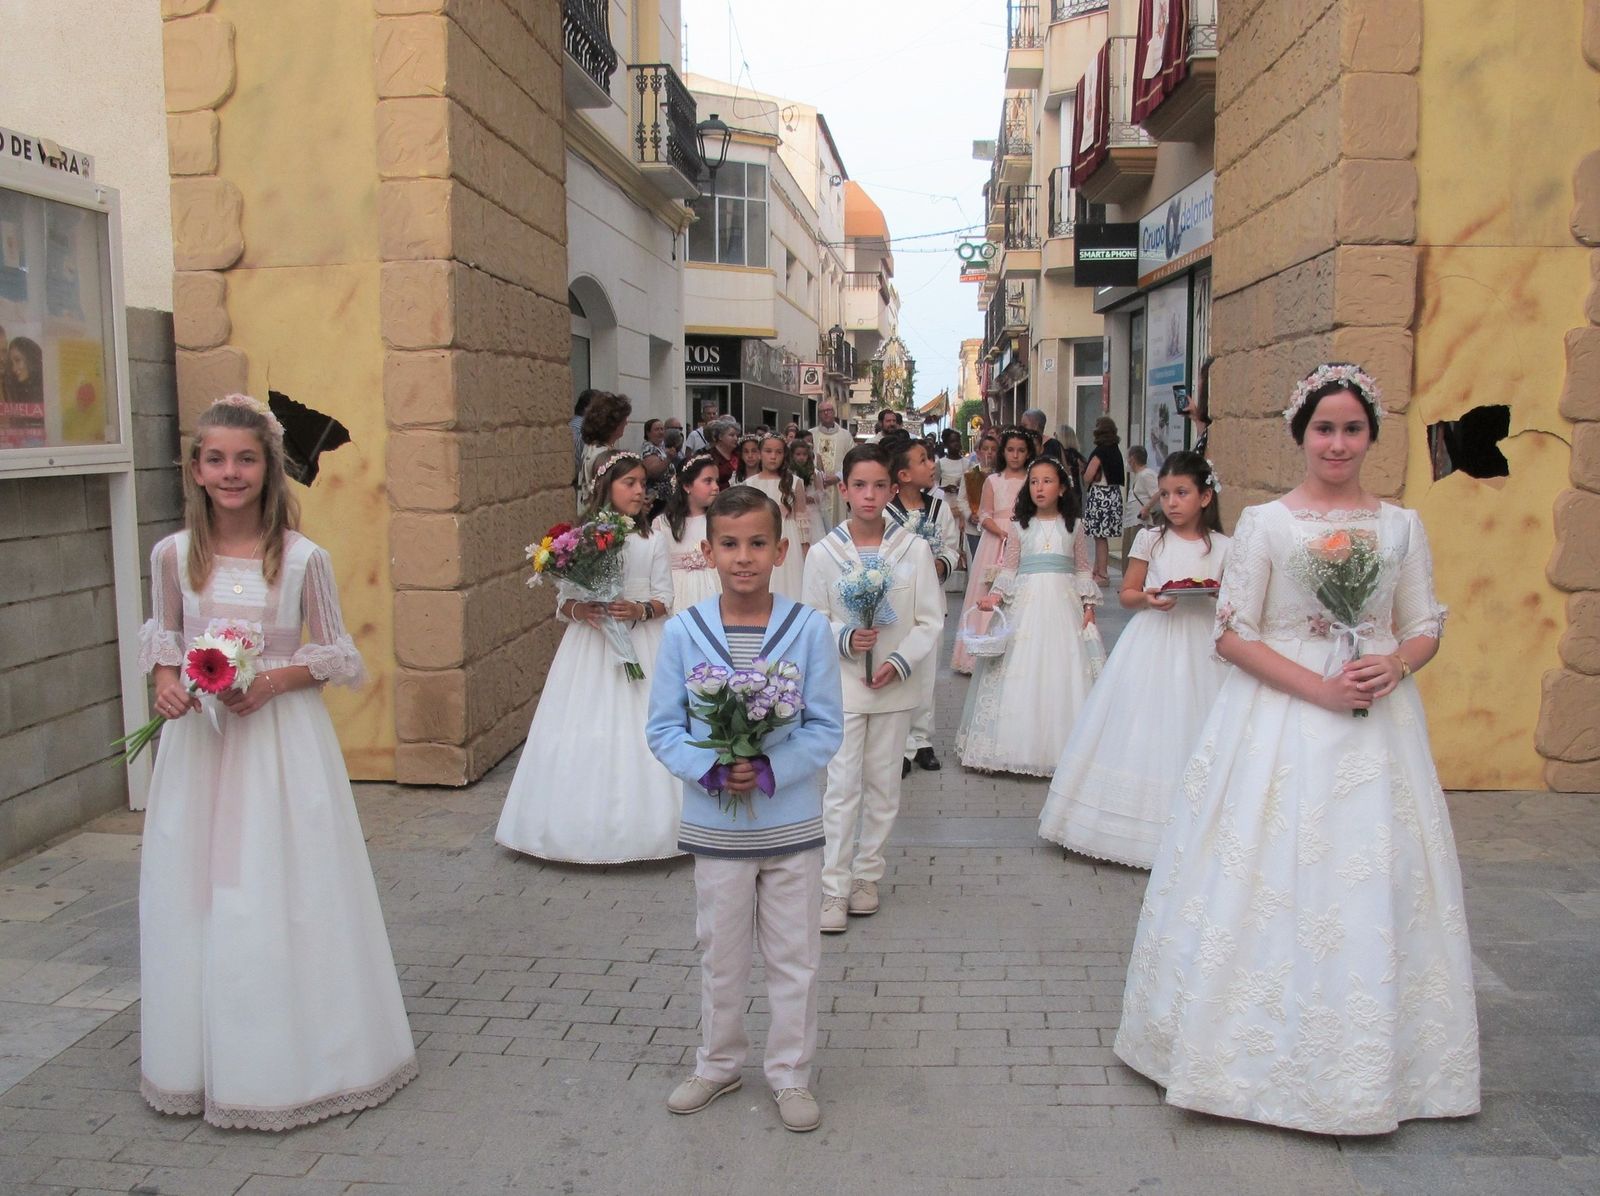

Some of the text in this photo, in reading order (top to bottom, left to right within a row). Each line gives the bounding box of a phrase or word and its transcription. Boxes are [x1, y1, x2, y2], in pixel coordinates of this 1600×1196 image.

[11, 135, 32, 161] DE
[1143, 225, 1166, 253] Grupo
[1080, 250, 1137, 258] SMART&PHONE
